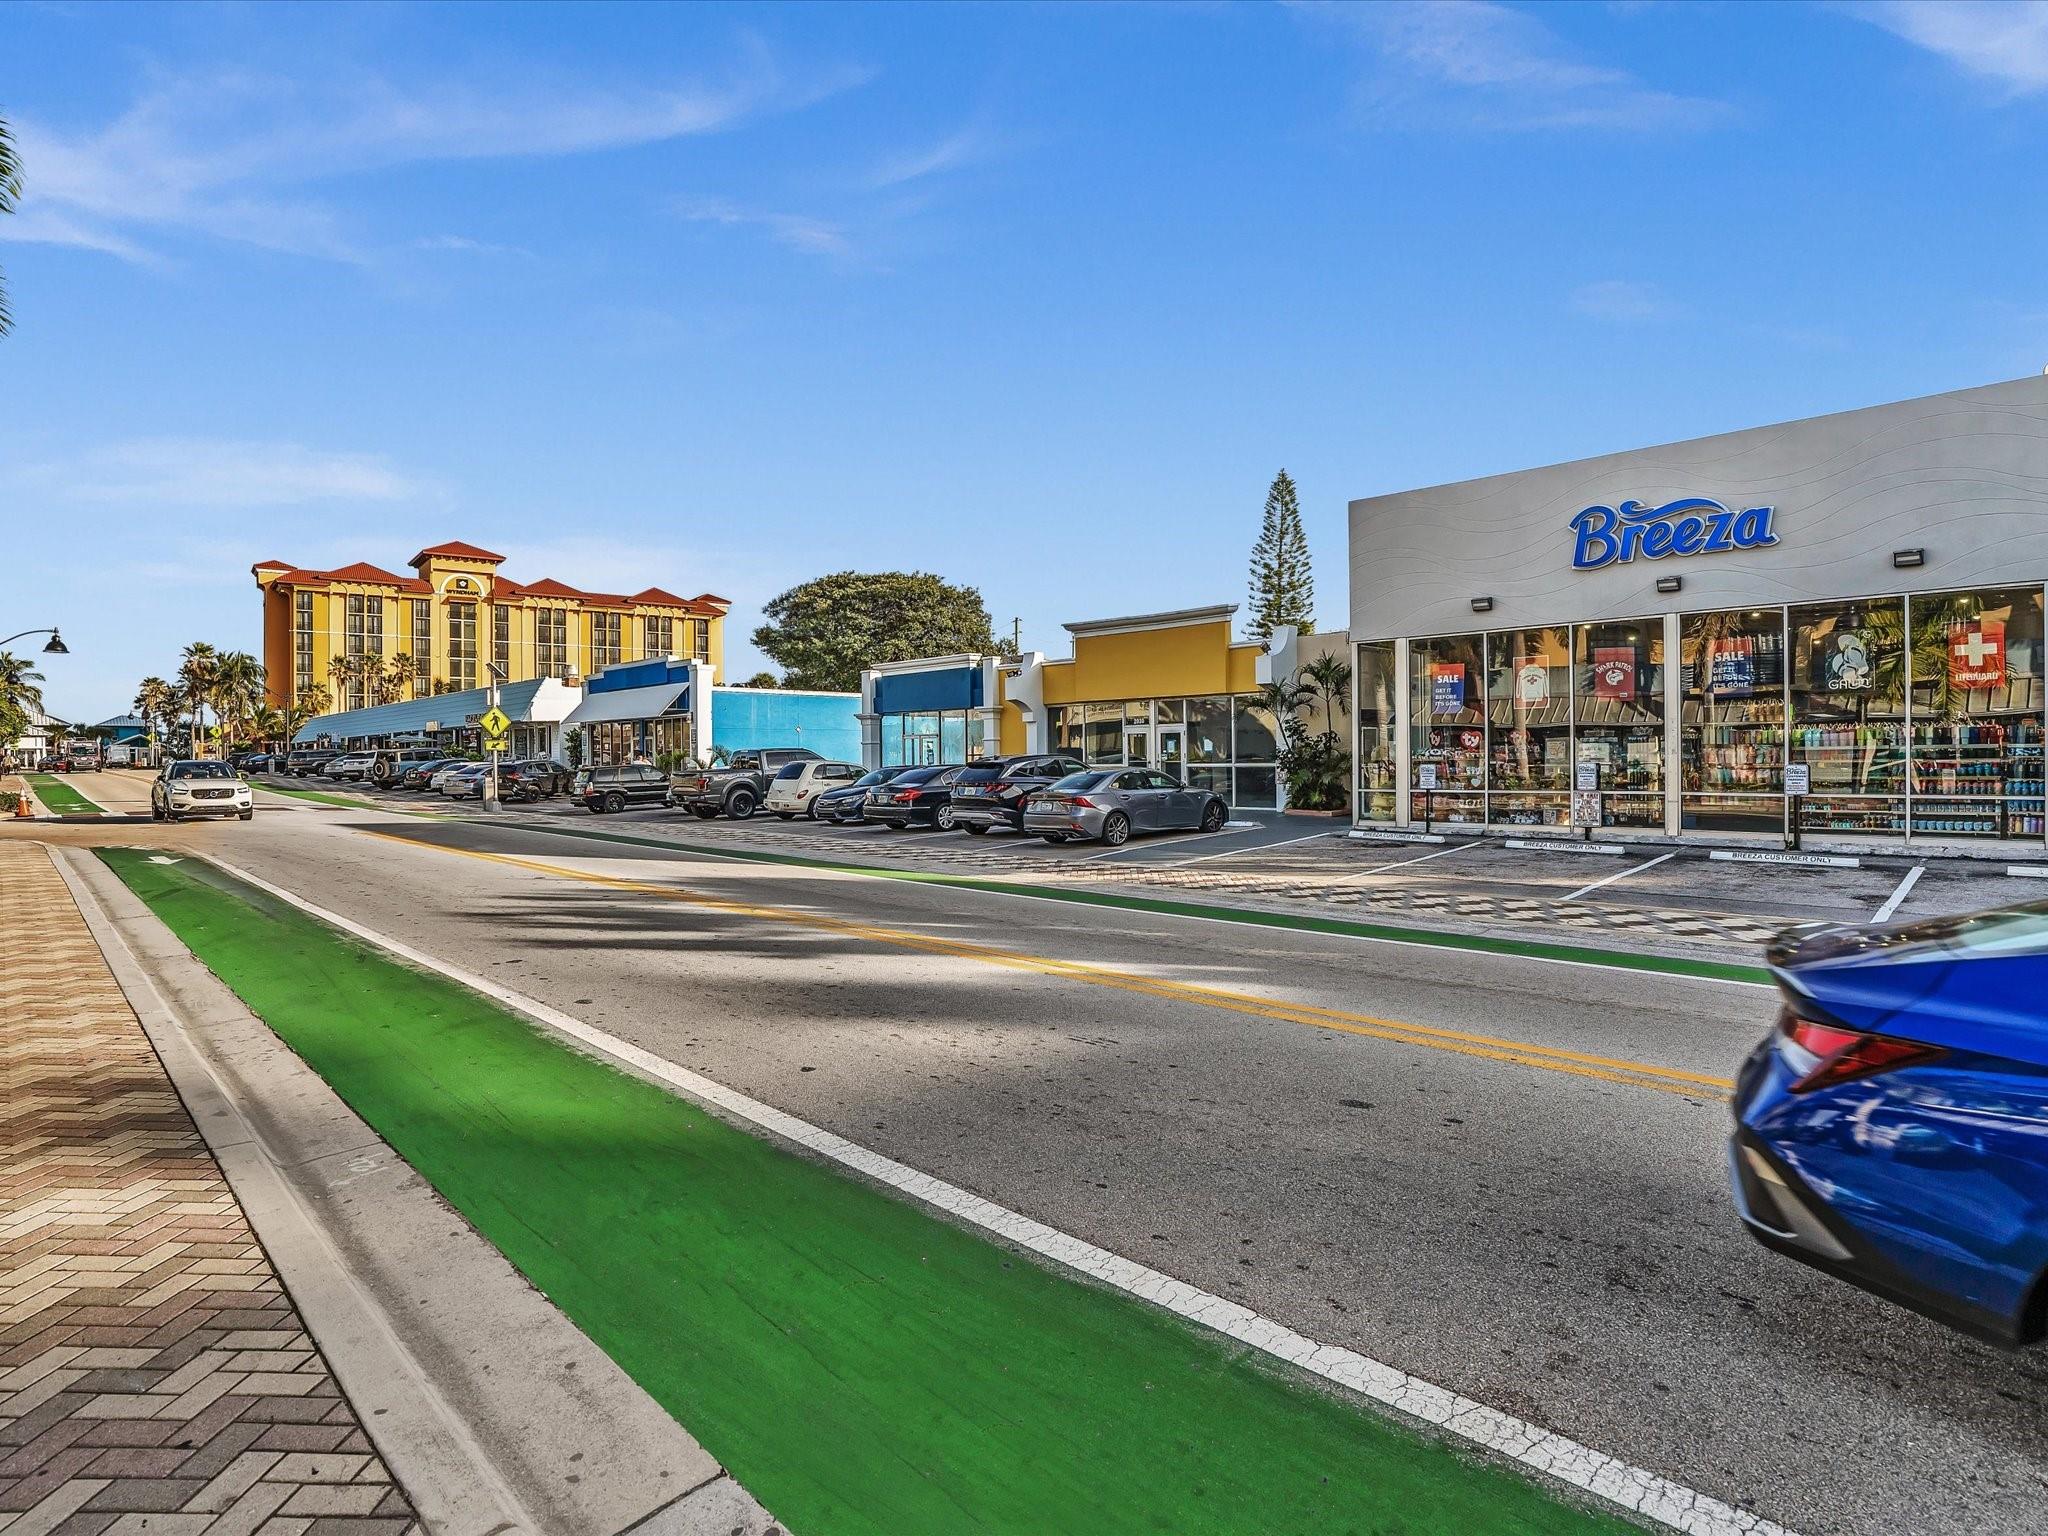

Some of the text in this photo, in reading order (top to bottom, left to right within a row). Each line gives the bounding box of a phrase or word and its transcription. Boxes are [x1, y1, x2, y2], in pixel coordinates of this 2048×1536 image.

[1568, 499, 1780, 569] Breeza
[1714, 651, 1745, 662] SALE
[1596, 662, 1615, 674] SHARK
[1437, 675, 1459, 684] SALE
[1727, 681, 1749, 689] GONE
[1429, 732, 1441, 747] ty
[1462, 733, 1480, 747] ty
[1731, 852, 1763, 860] BREEZA
[1764, 853, 1809, 862] CUSTOMER
